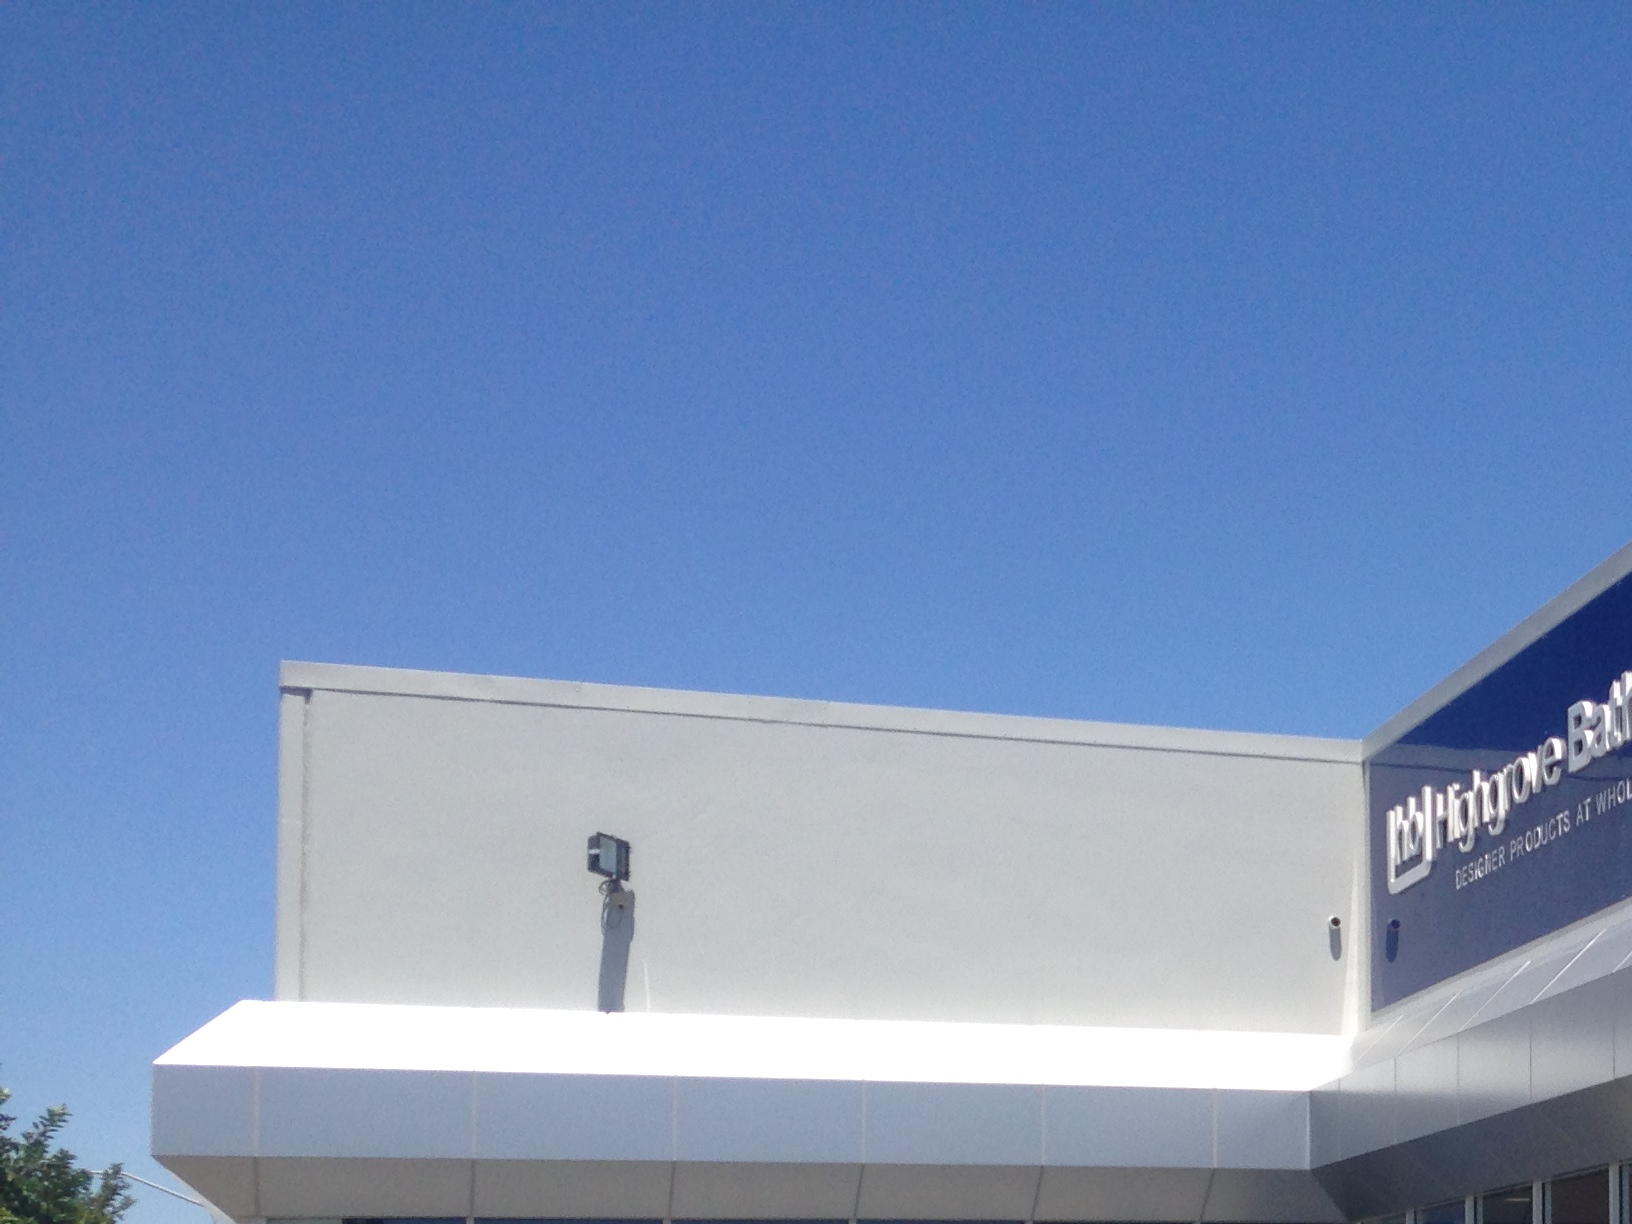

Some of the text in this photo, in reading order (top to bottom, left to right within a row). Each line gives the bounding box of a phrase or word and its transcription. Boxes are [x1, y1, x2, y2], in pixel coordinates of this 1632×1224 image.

[1436, 736, 1567, 853] Highgrove
[1455, 845, 1507, 890] DESIGNER
[1510, 809, 1571, 862] PRODUCTS
[1576, 797, 1591, 827] AT
